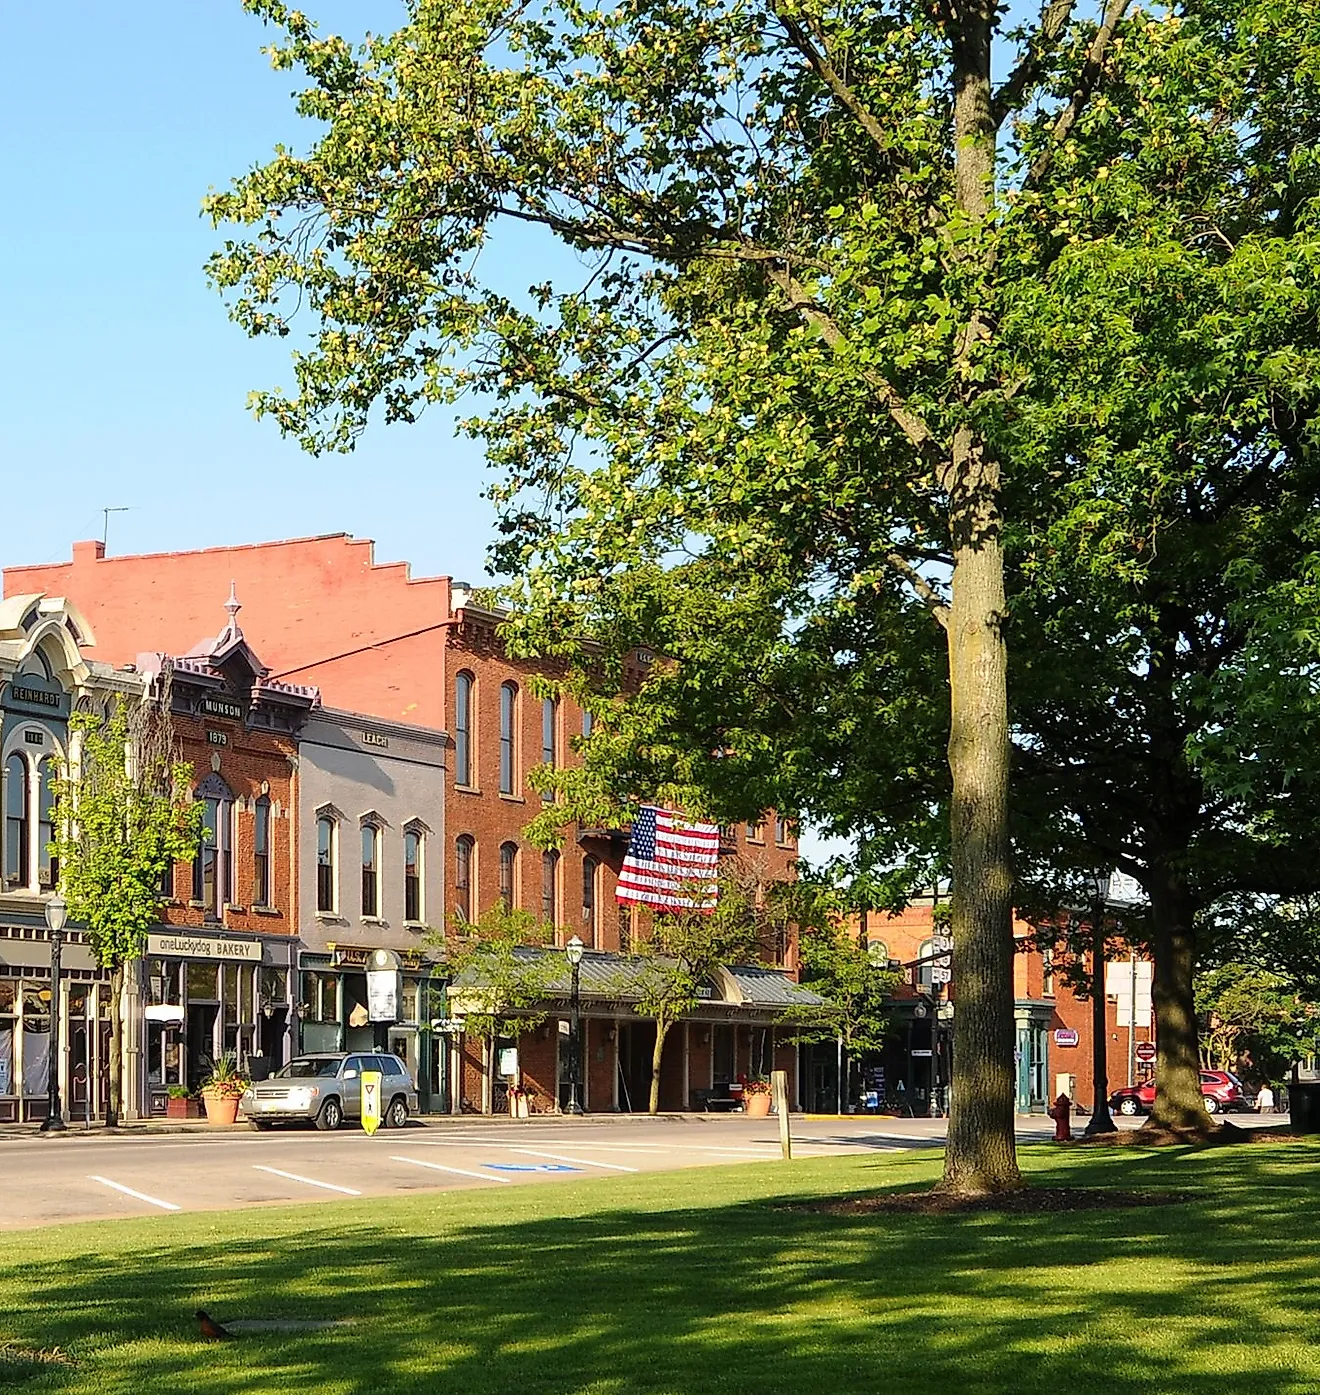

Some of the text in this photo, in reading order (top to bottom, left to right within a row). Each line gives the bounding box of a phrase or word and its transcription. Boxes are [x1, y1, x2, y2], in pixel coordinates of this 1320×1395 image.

[13, 688, 60, 706] REINHARDT
[205, 699, 241, 717] MUNSON
[362, 731, 388, 746] LEACH
[216, 943, 251, 956] BAKERY
